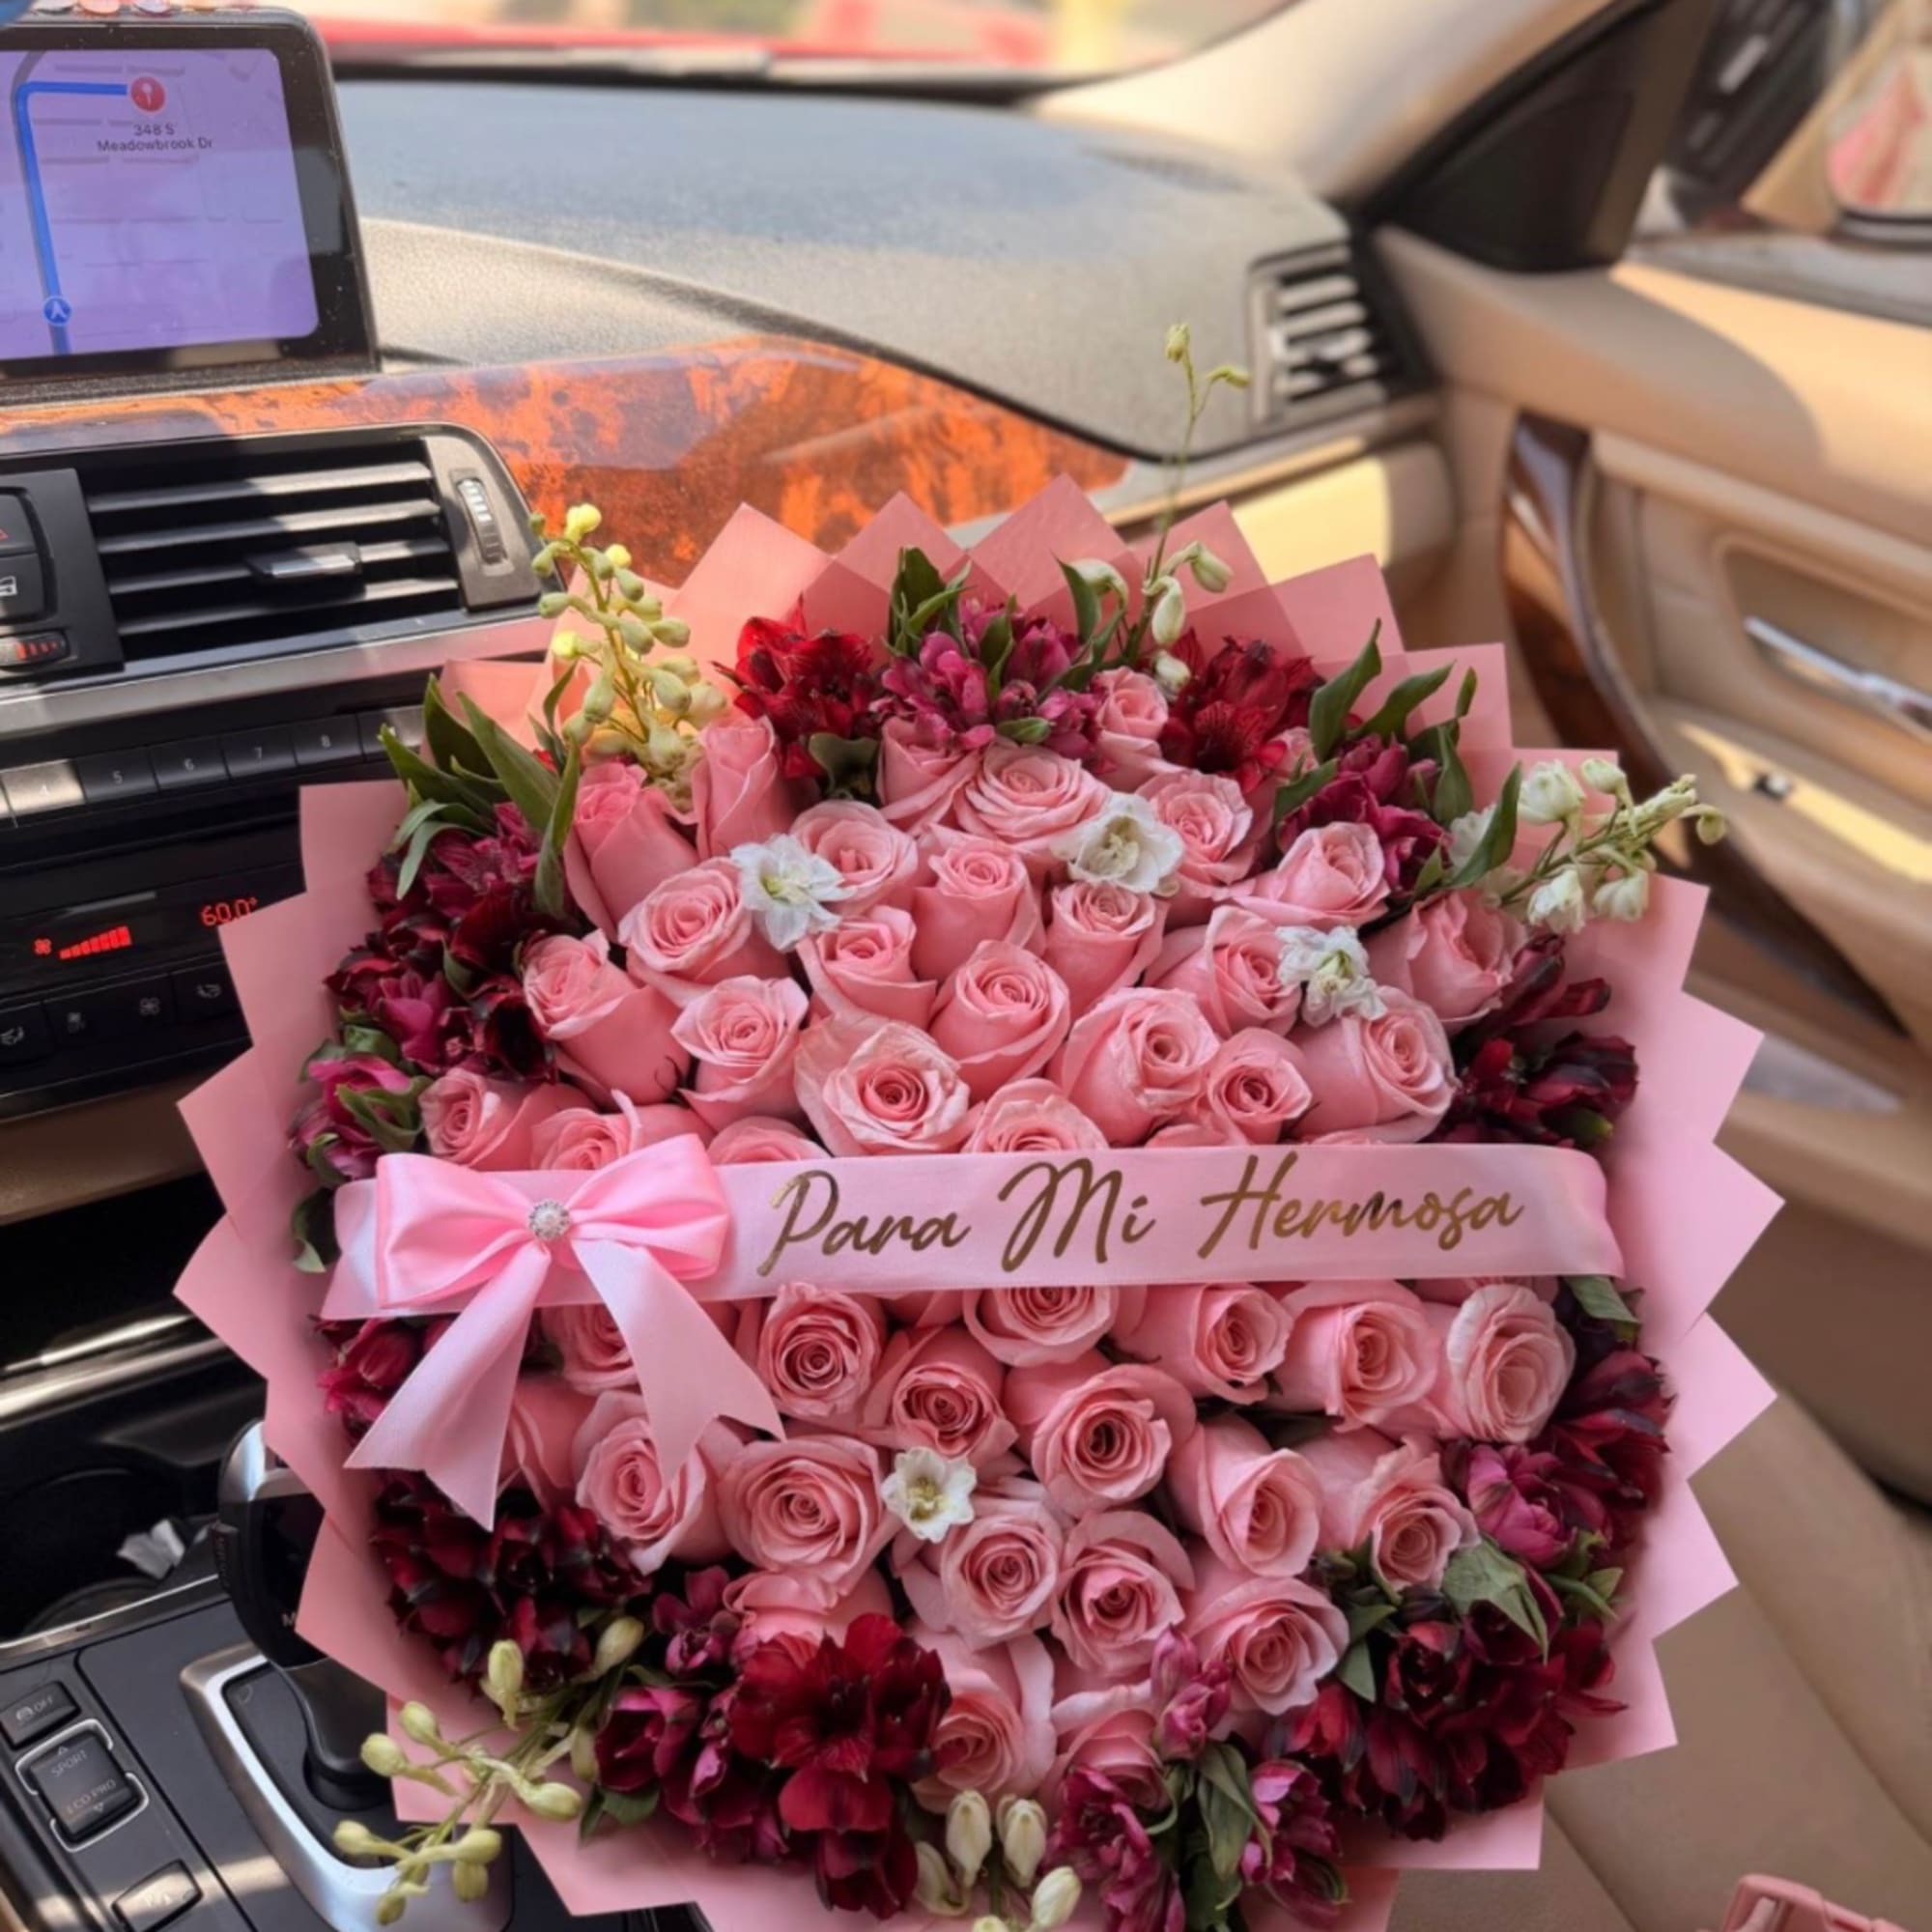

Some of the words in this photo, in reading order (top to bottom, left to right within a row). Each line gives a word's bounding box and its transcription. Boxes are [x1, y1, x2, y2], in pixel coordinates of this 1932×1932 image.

[133, 123, 162, 136] 348
[164, 122, 176, 136] S
[97, 138, 195, 152] Meadowbrook
[197, 137, 213, 149] Dr
[320, 733, 331, 749] 8
[254, 747, 264, 761] 7
[184, 758, 195, 772] 6
[112, 770, 124, 784] 5
[756, 1169, 970, 1276] Para
[997, 1158, 1156, 1272] Mi
[1197, 1151, 1524, 1259] Hermosa
[51, 1749, 88, 1777] SPORT
